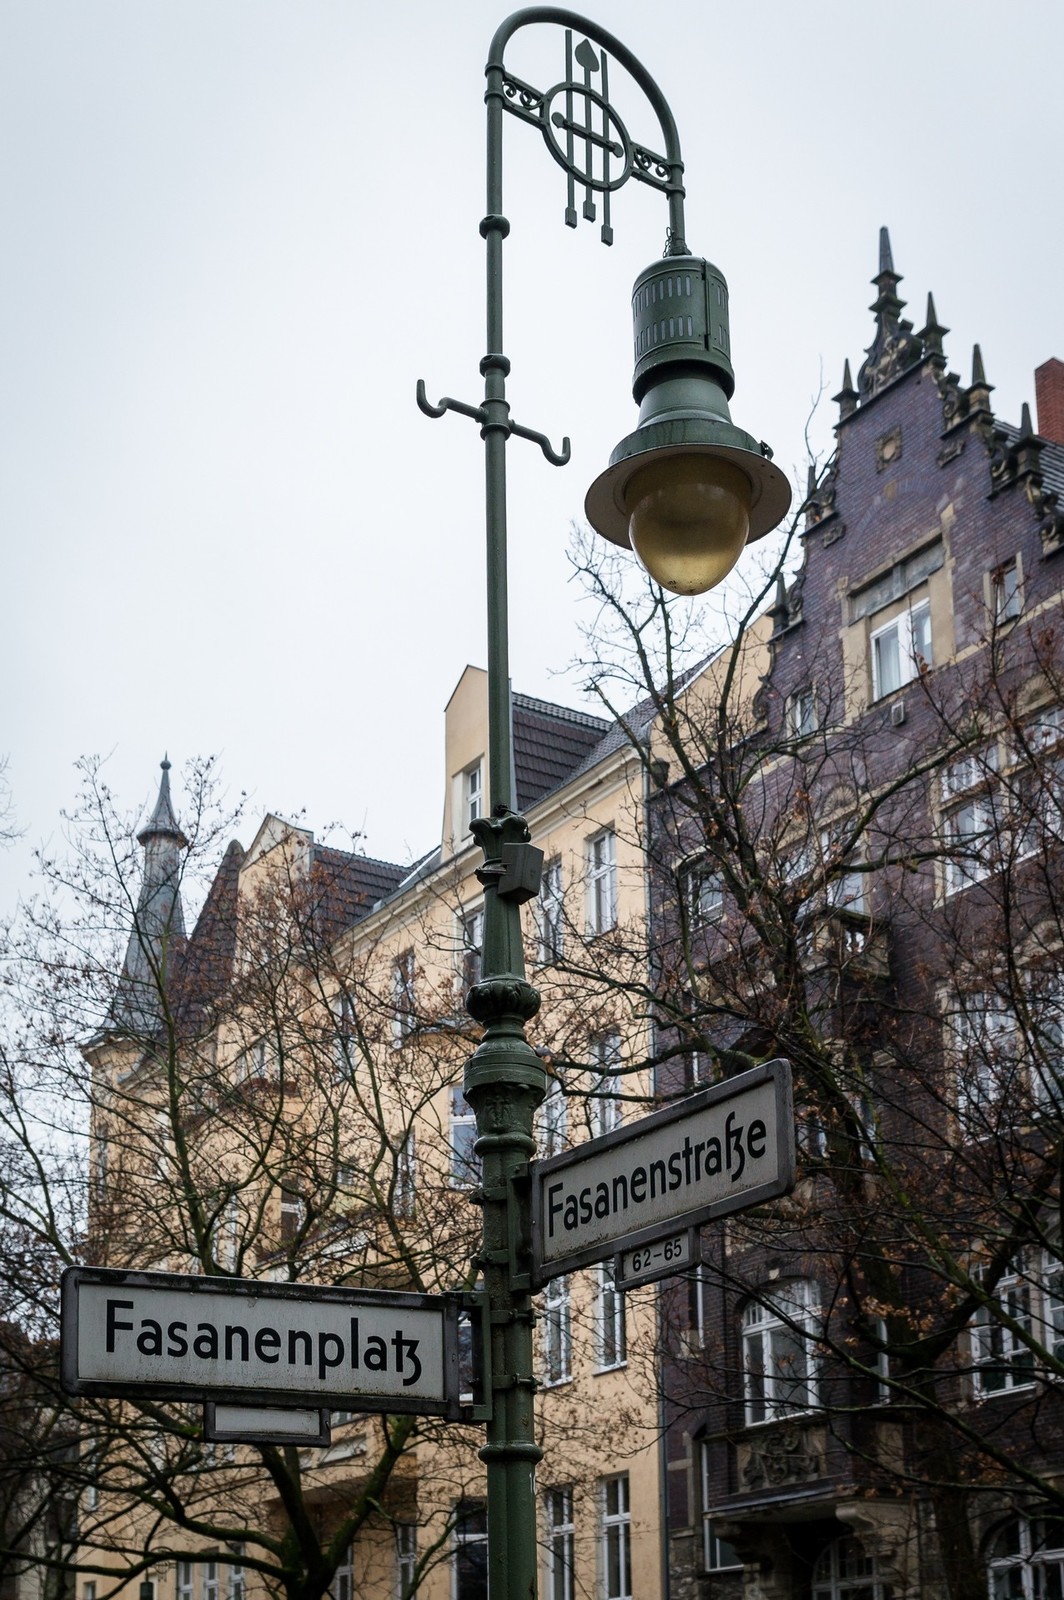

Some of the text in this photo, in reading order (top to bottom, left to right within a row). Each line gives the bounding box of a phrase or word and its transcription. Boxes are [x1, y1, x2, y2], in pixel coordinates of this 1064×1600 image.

[548, 1111, 767, 1238] Fasanenstraße
[632, 1238, 682, 1272] 62-65
[106, 1299, 422, 1386] Fasanenplatz
